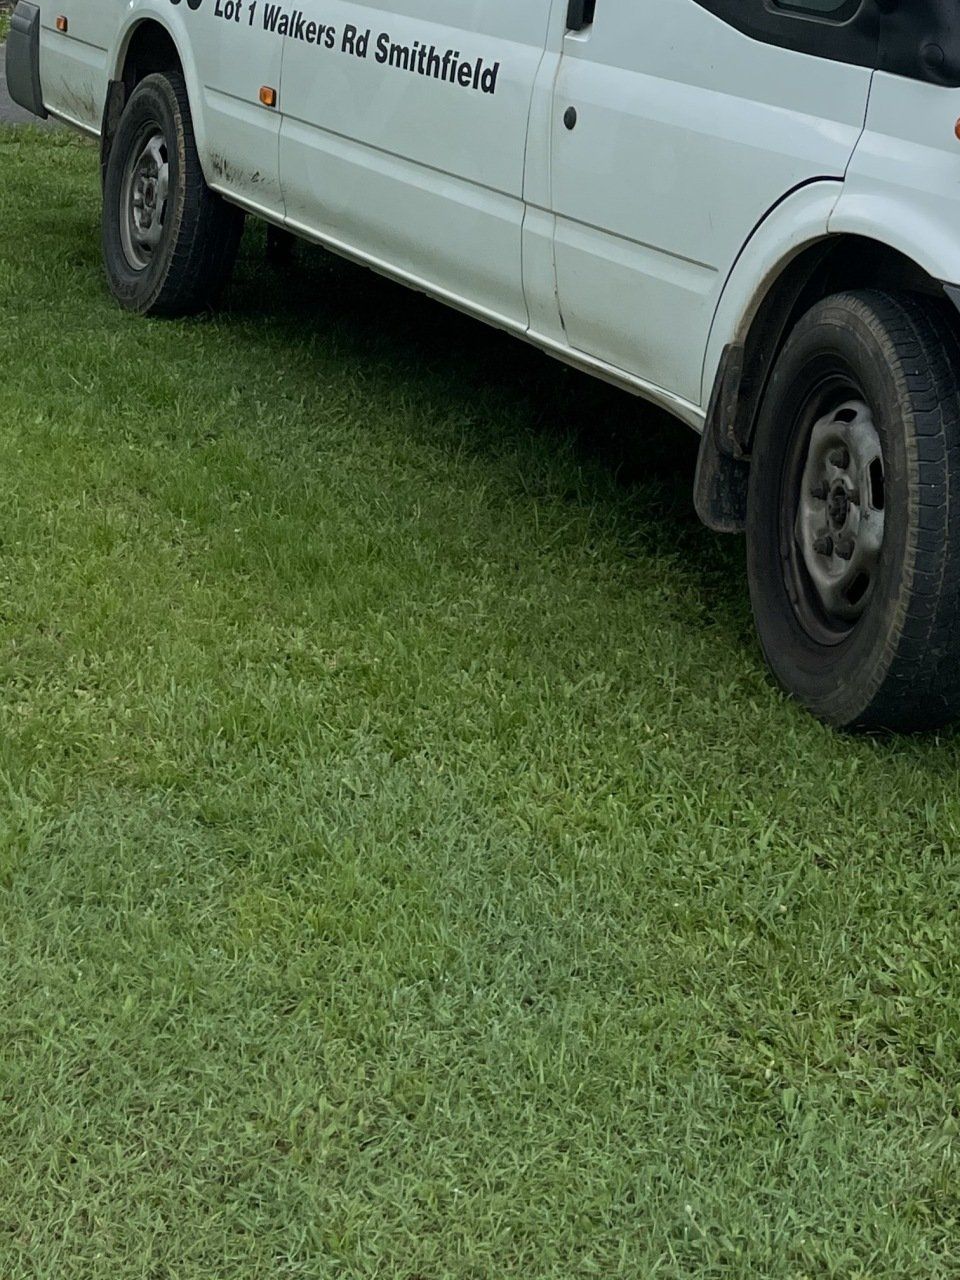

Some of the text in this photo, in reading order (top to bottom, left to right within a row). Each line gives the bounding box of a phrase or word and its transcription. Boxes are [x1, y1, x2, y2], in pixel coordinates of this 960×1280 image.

[248, 0, 257, 26] 1
[263, 4, 335, 48] Walkers
[341, 24, 368, 58] Rd
[374, 33, 500, 94] Smithfield
